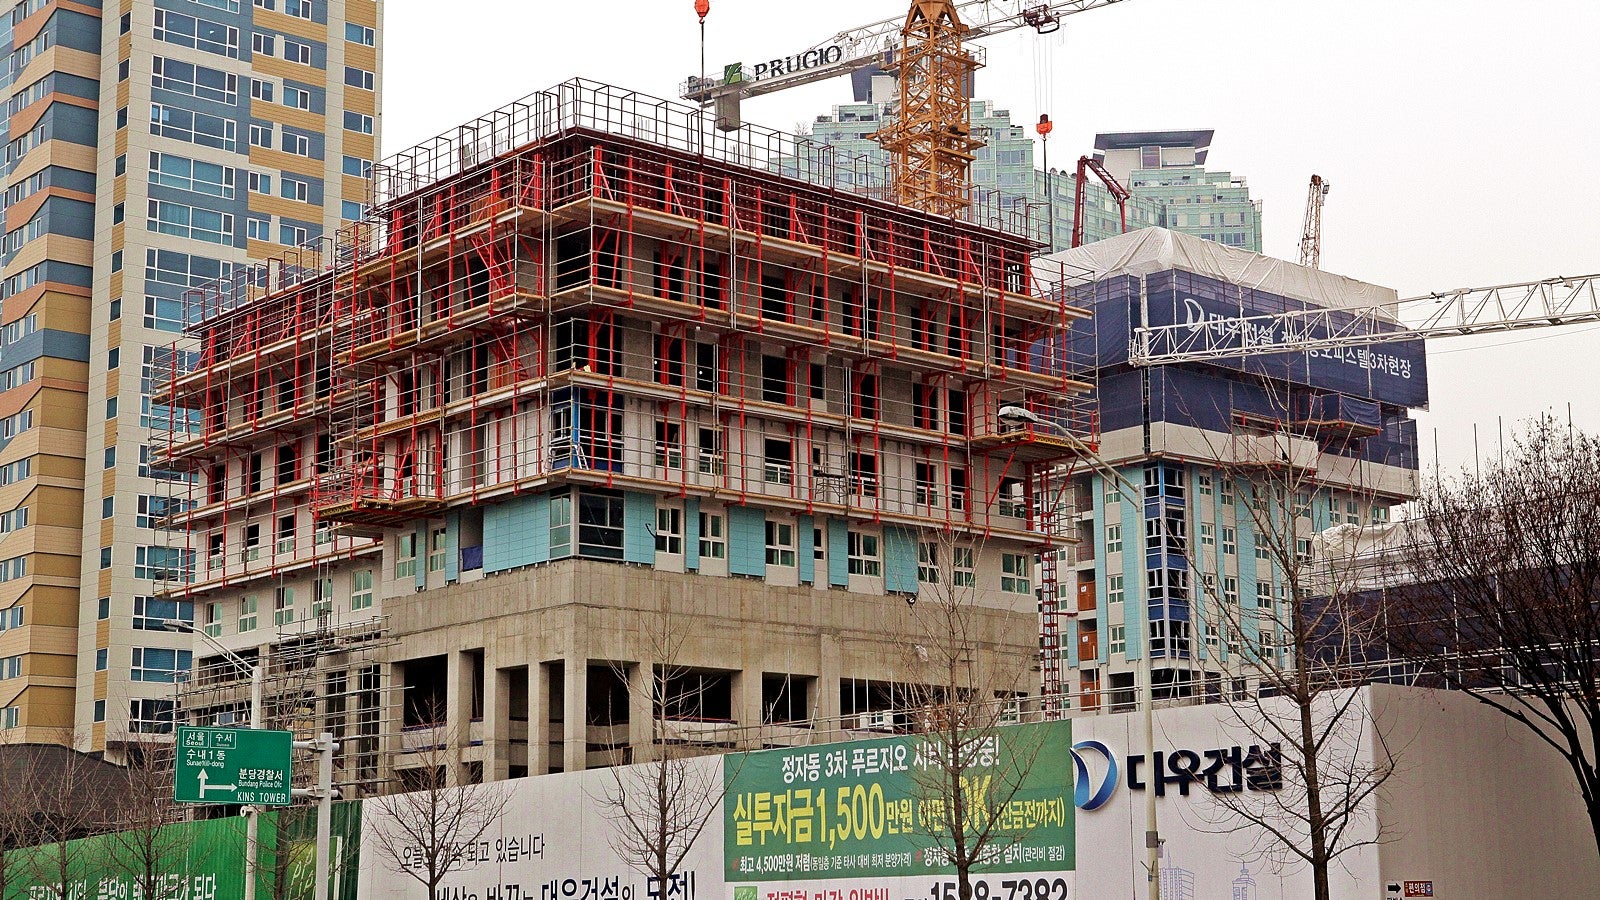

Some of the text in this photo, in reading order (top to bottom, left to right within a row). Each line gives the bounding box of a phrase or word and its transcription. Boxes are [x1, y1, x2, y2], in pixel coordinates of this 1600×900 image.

[754, 45, 841, 81] PRUGIO
[187, 732, 204, 741] 서울
[215, 733, 232, 743] 수서
[781, 753, 820, 783] 정자동
[825, 749, 848, 778] 3차
[851, 744, 909, 777] 푸르지오
[1127, 743, 1282, 797] 대우건설
[239, 768, 283, 781] 분당경찰서
[239, 780, 258, 789] Bundang
[237, 792, 286, 803] KINS TOWER
[467, 839, 490, 866] 되고
[495, 833, 545, 864] 있습니다
[1048, 844, 1065, 862] 절감)
[739, 856, 755, 874] 최고
[755, 853, 794, 875] 4,500만원
[831, 855, 843, 870] 기준
[857, 853, 870, 869] 대비
[871, 852, 884, 869] 최저
[1408, 882, 1426, 894] 편의점
